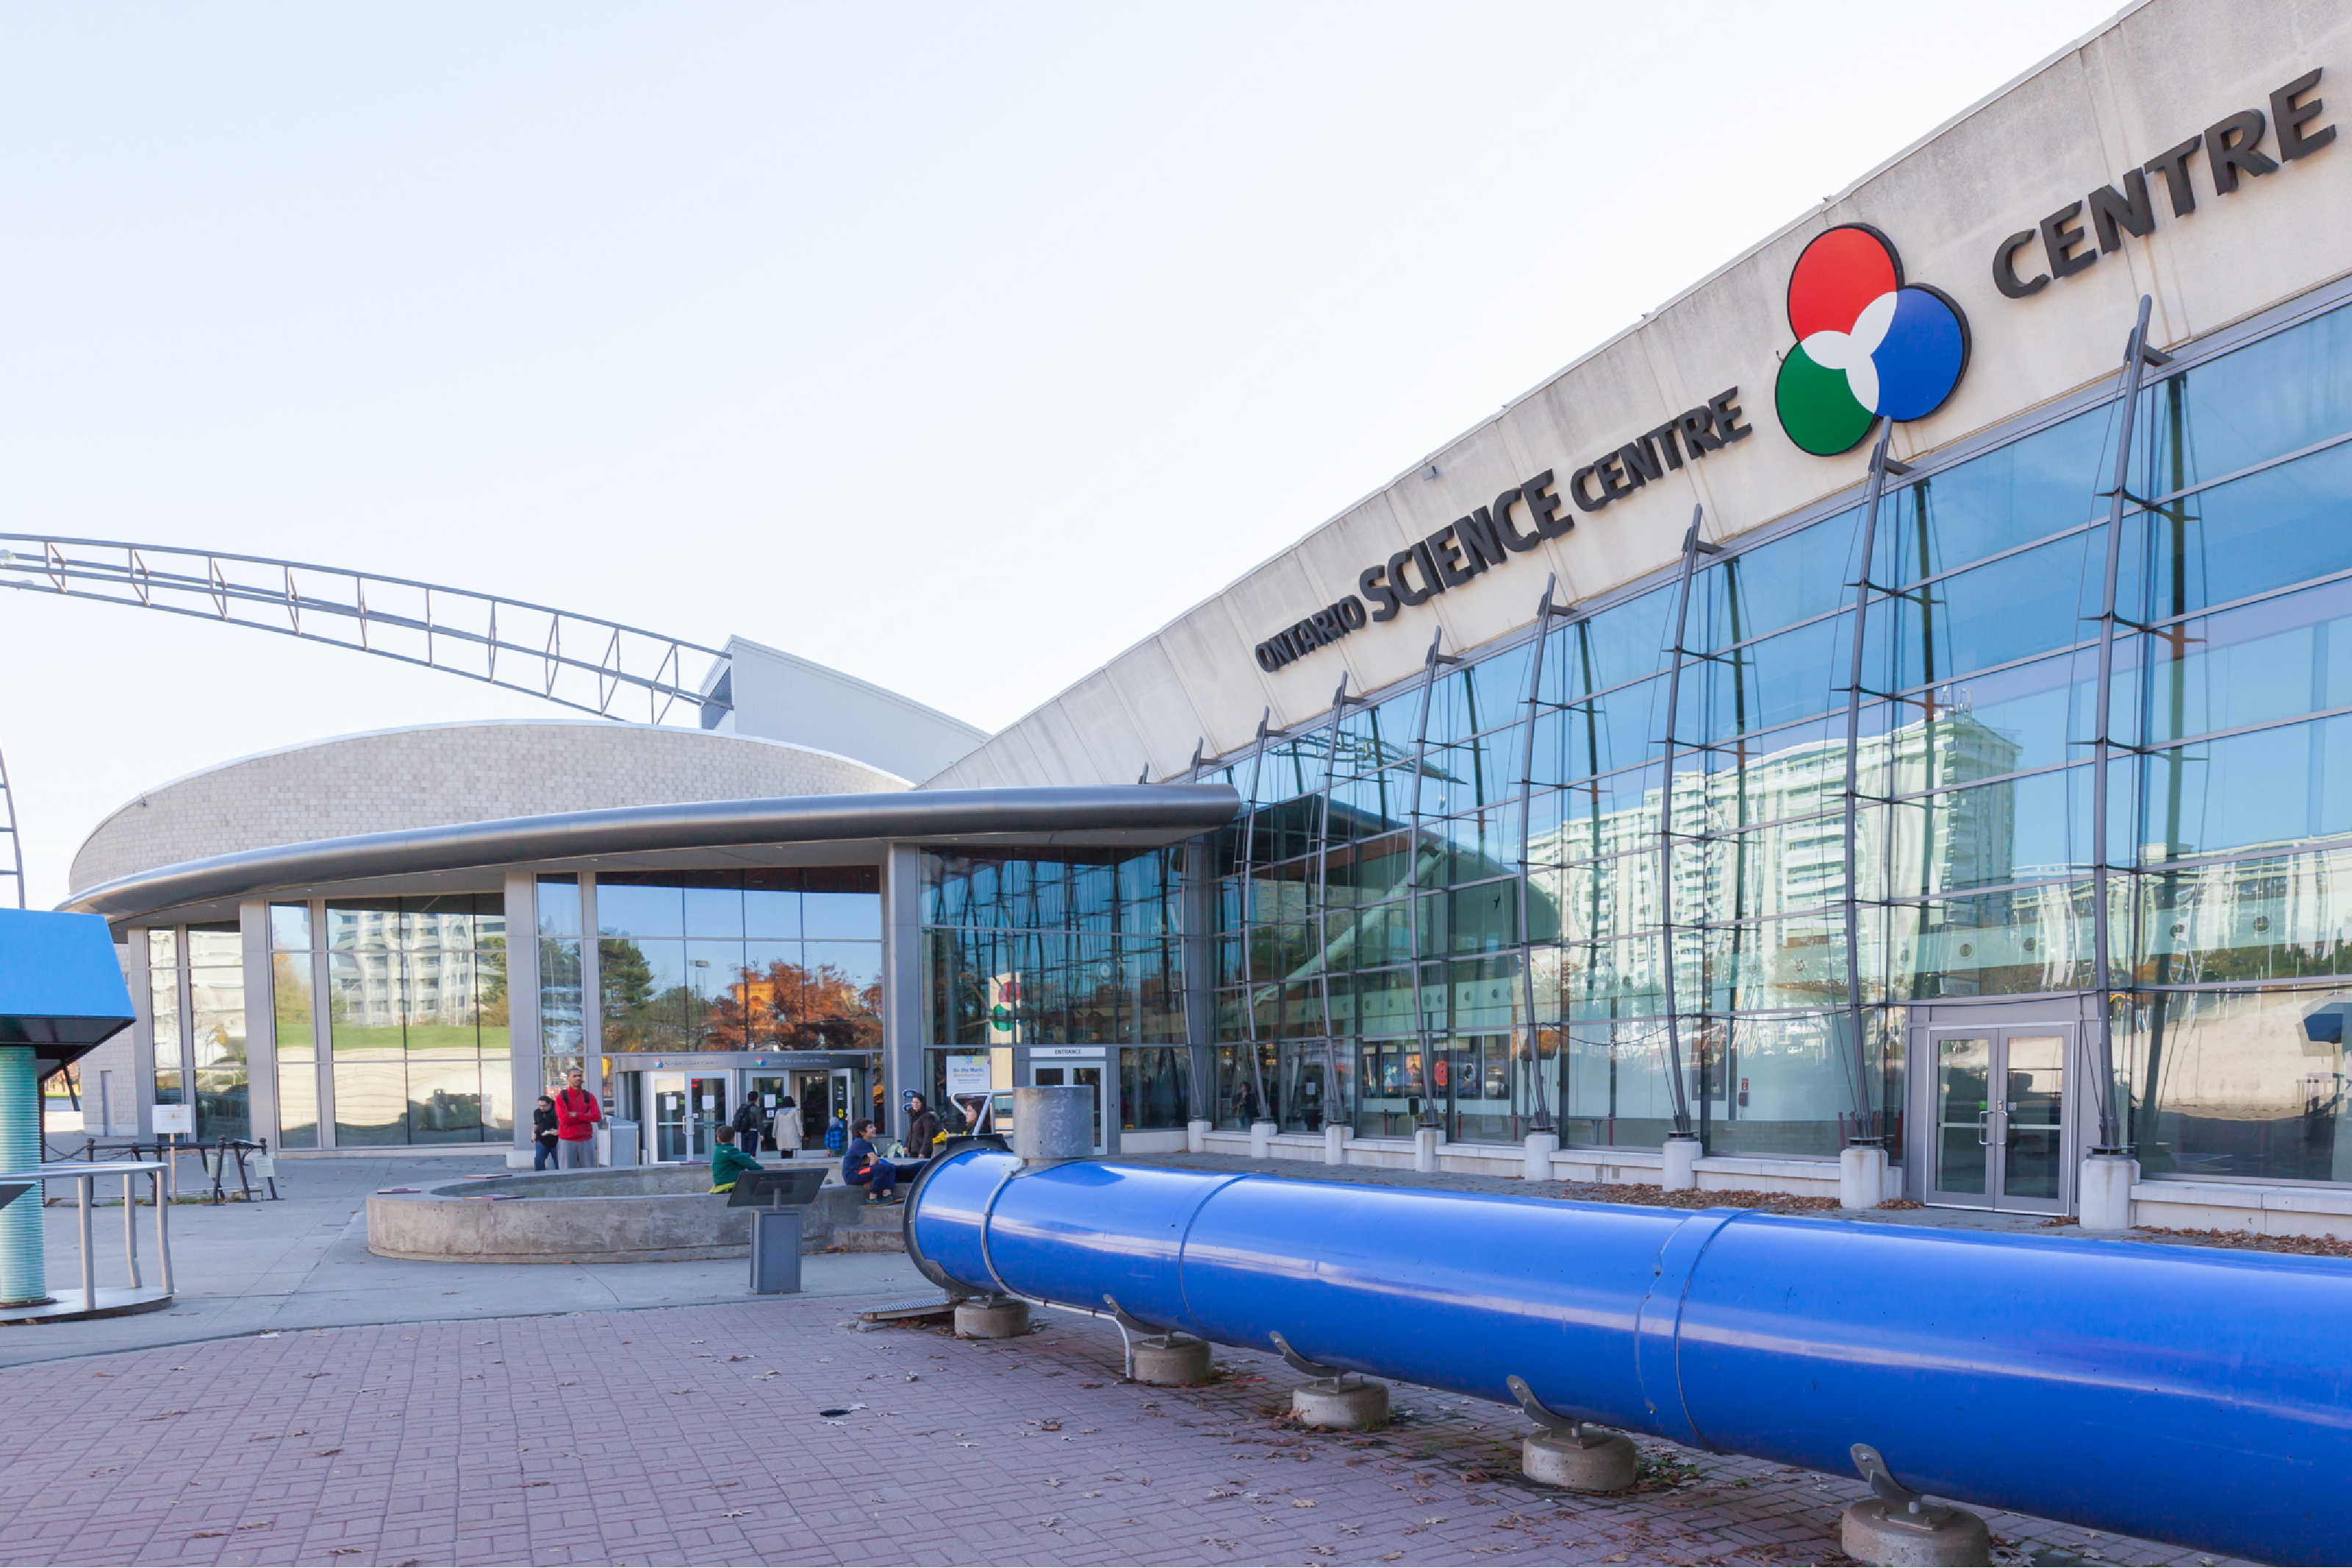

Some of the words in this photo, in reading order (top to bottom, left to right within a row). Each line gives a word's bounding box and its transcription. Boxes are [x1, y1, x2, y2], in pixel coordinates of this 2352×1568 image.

[1993, 67, 2337, 299] CENTRE
[1255, 594, 1366, 672] ONTARIO
[1359, 468, 1575, 622] SCIENCE
[1570, 385, 1753, 513] CENTRE
